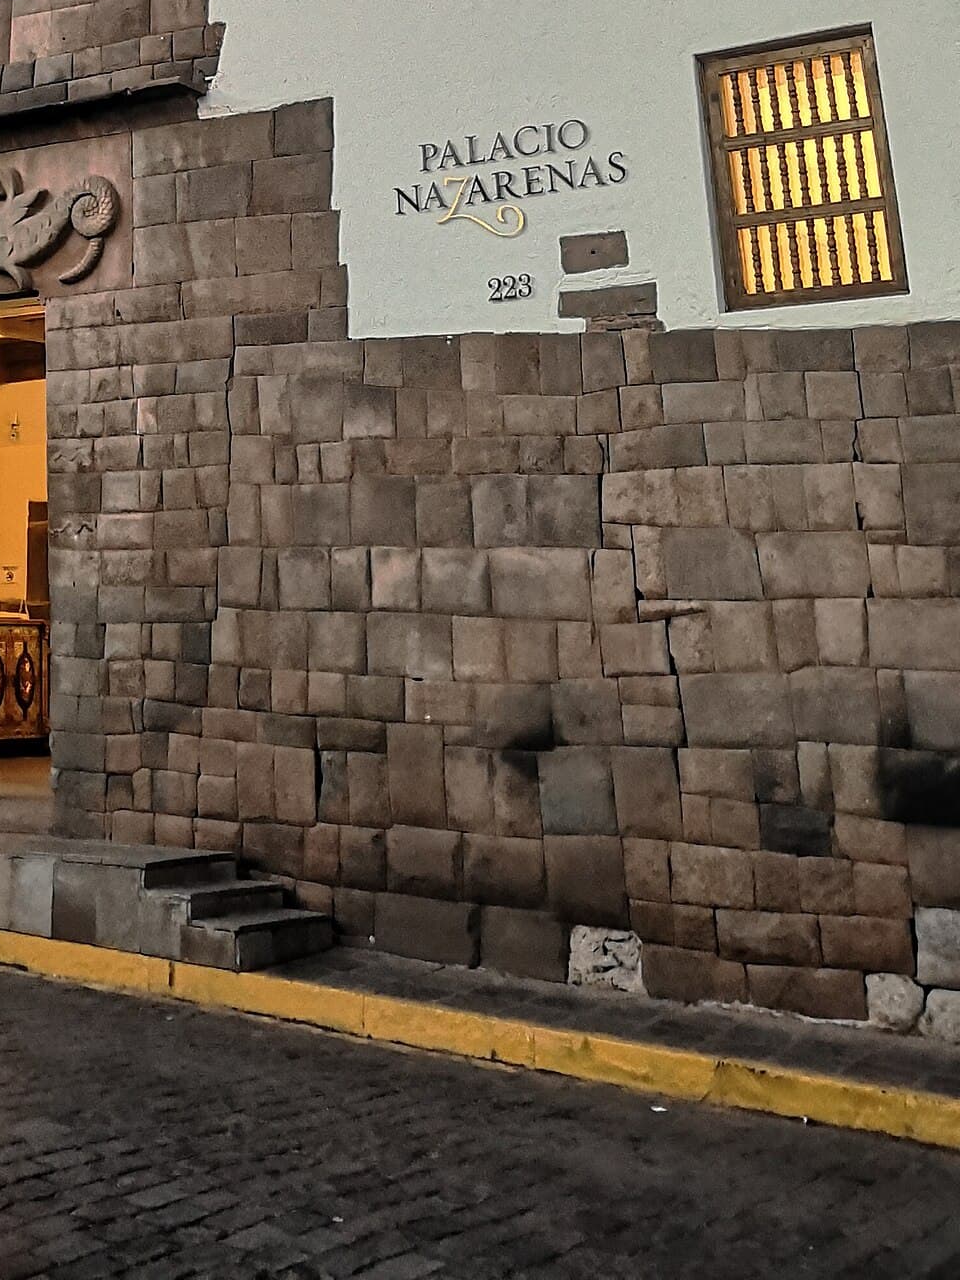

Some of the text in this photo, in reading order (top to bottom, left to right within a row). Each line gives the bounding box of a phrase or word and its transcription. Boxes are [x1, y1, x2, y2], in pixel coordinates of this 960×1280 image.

[418, 119, 589, 172] PALACIO
[393, 151, 627, 237] NAZARENAS
[488, 274, 532, 302] 223
